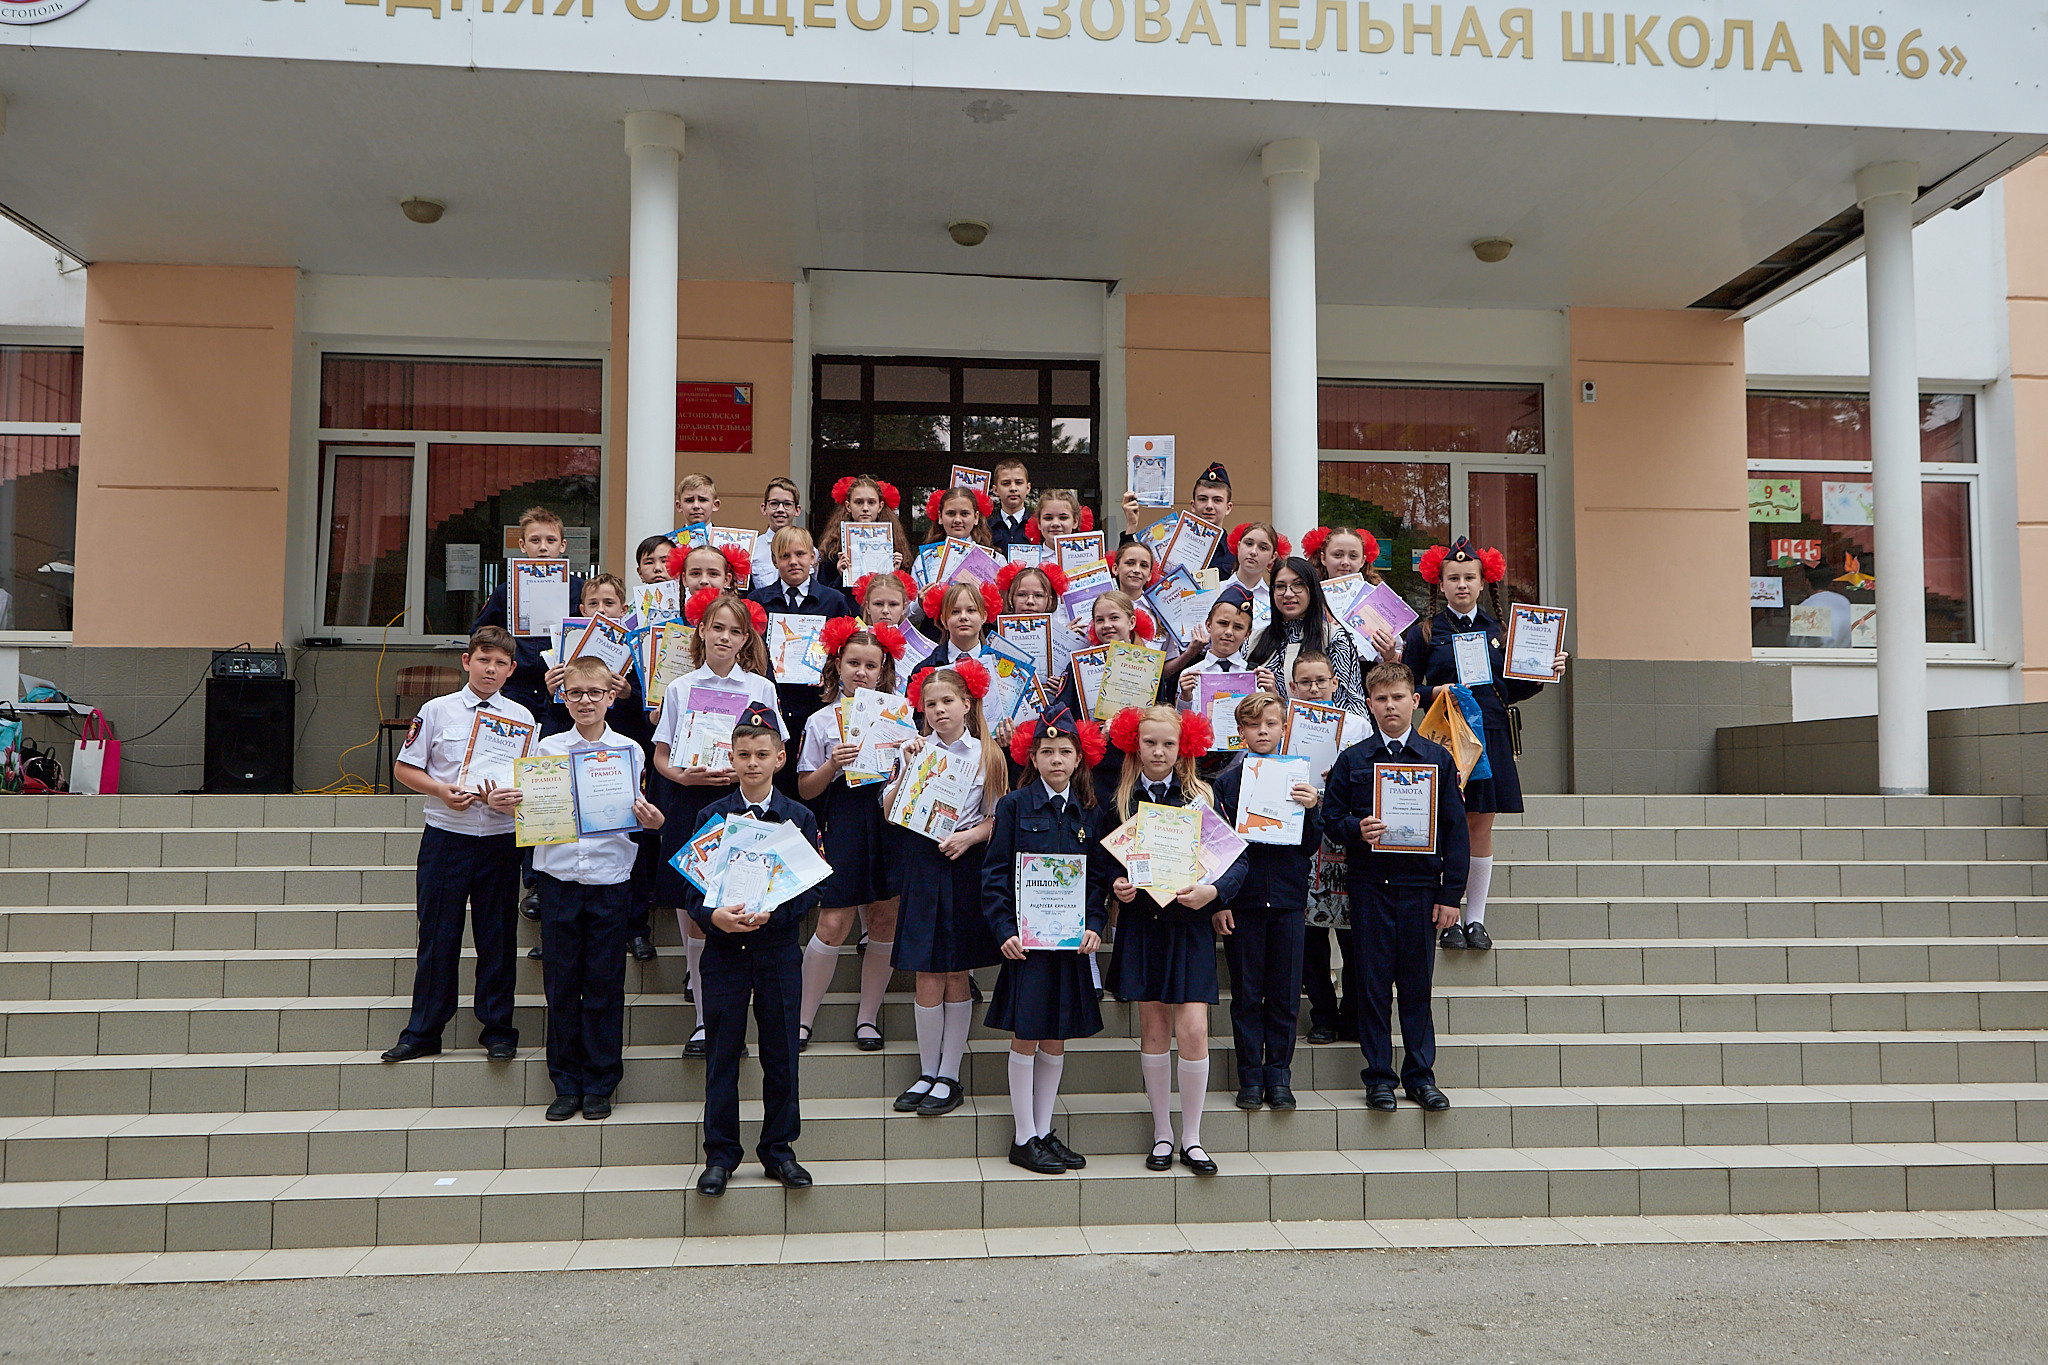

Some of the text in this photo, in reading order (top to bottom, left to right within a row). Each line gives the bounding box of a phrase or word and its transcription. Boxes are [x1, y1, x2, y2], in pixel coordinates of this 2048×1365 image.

[1561, 10, 1803, 73] ШКОЛА
[679, 434, 708, 442] ШКОЛА
[1764, 485, 1773, 499] 9
[1184, 532, 1206, 547] ГРАМОТА
[1771, 538, 1822, 561] 1945
[1067, 552, 1094, 560] ГРАМОТА
[1521, 624, 1553, 633] ГРАМОТА
[1011, 633, 1041, 641] ГРАМОТА
[595, 637, 623, 657] ГРАМОТА
[1120, 662, 1147, 673] ГРАМОТА
[1299, 722, 1331, 734] ГРАМОТА
[484, 735, 517, 749] ГРАМОТА
[590, 770, 622, 778] ГРАМОТА
[531, 776, 562, 784] ГРАМОТА
[1389, 787, 1424, 795] ГРАМОТА
[1154, 825, 1184, 835] ГРАМОТА
[1025, 879, 1059, 888] ДИПЛОМ
